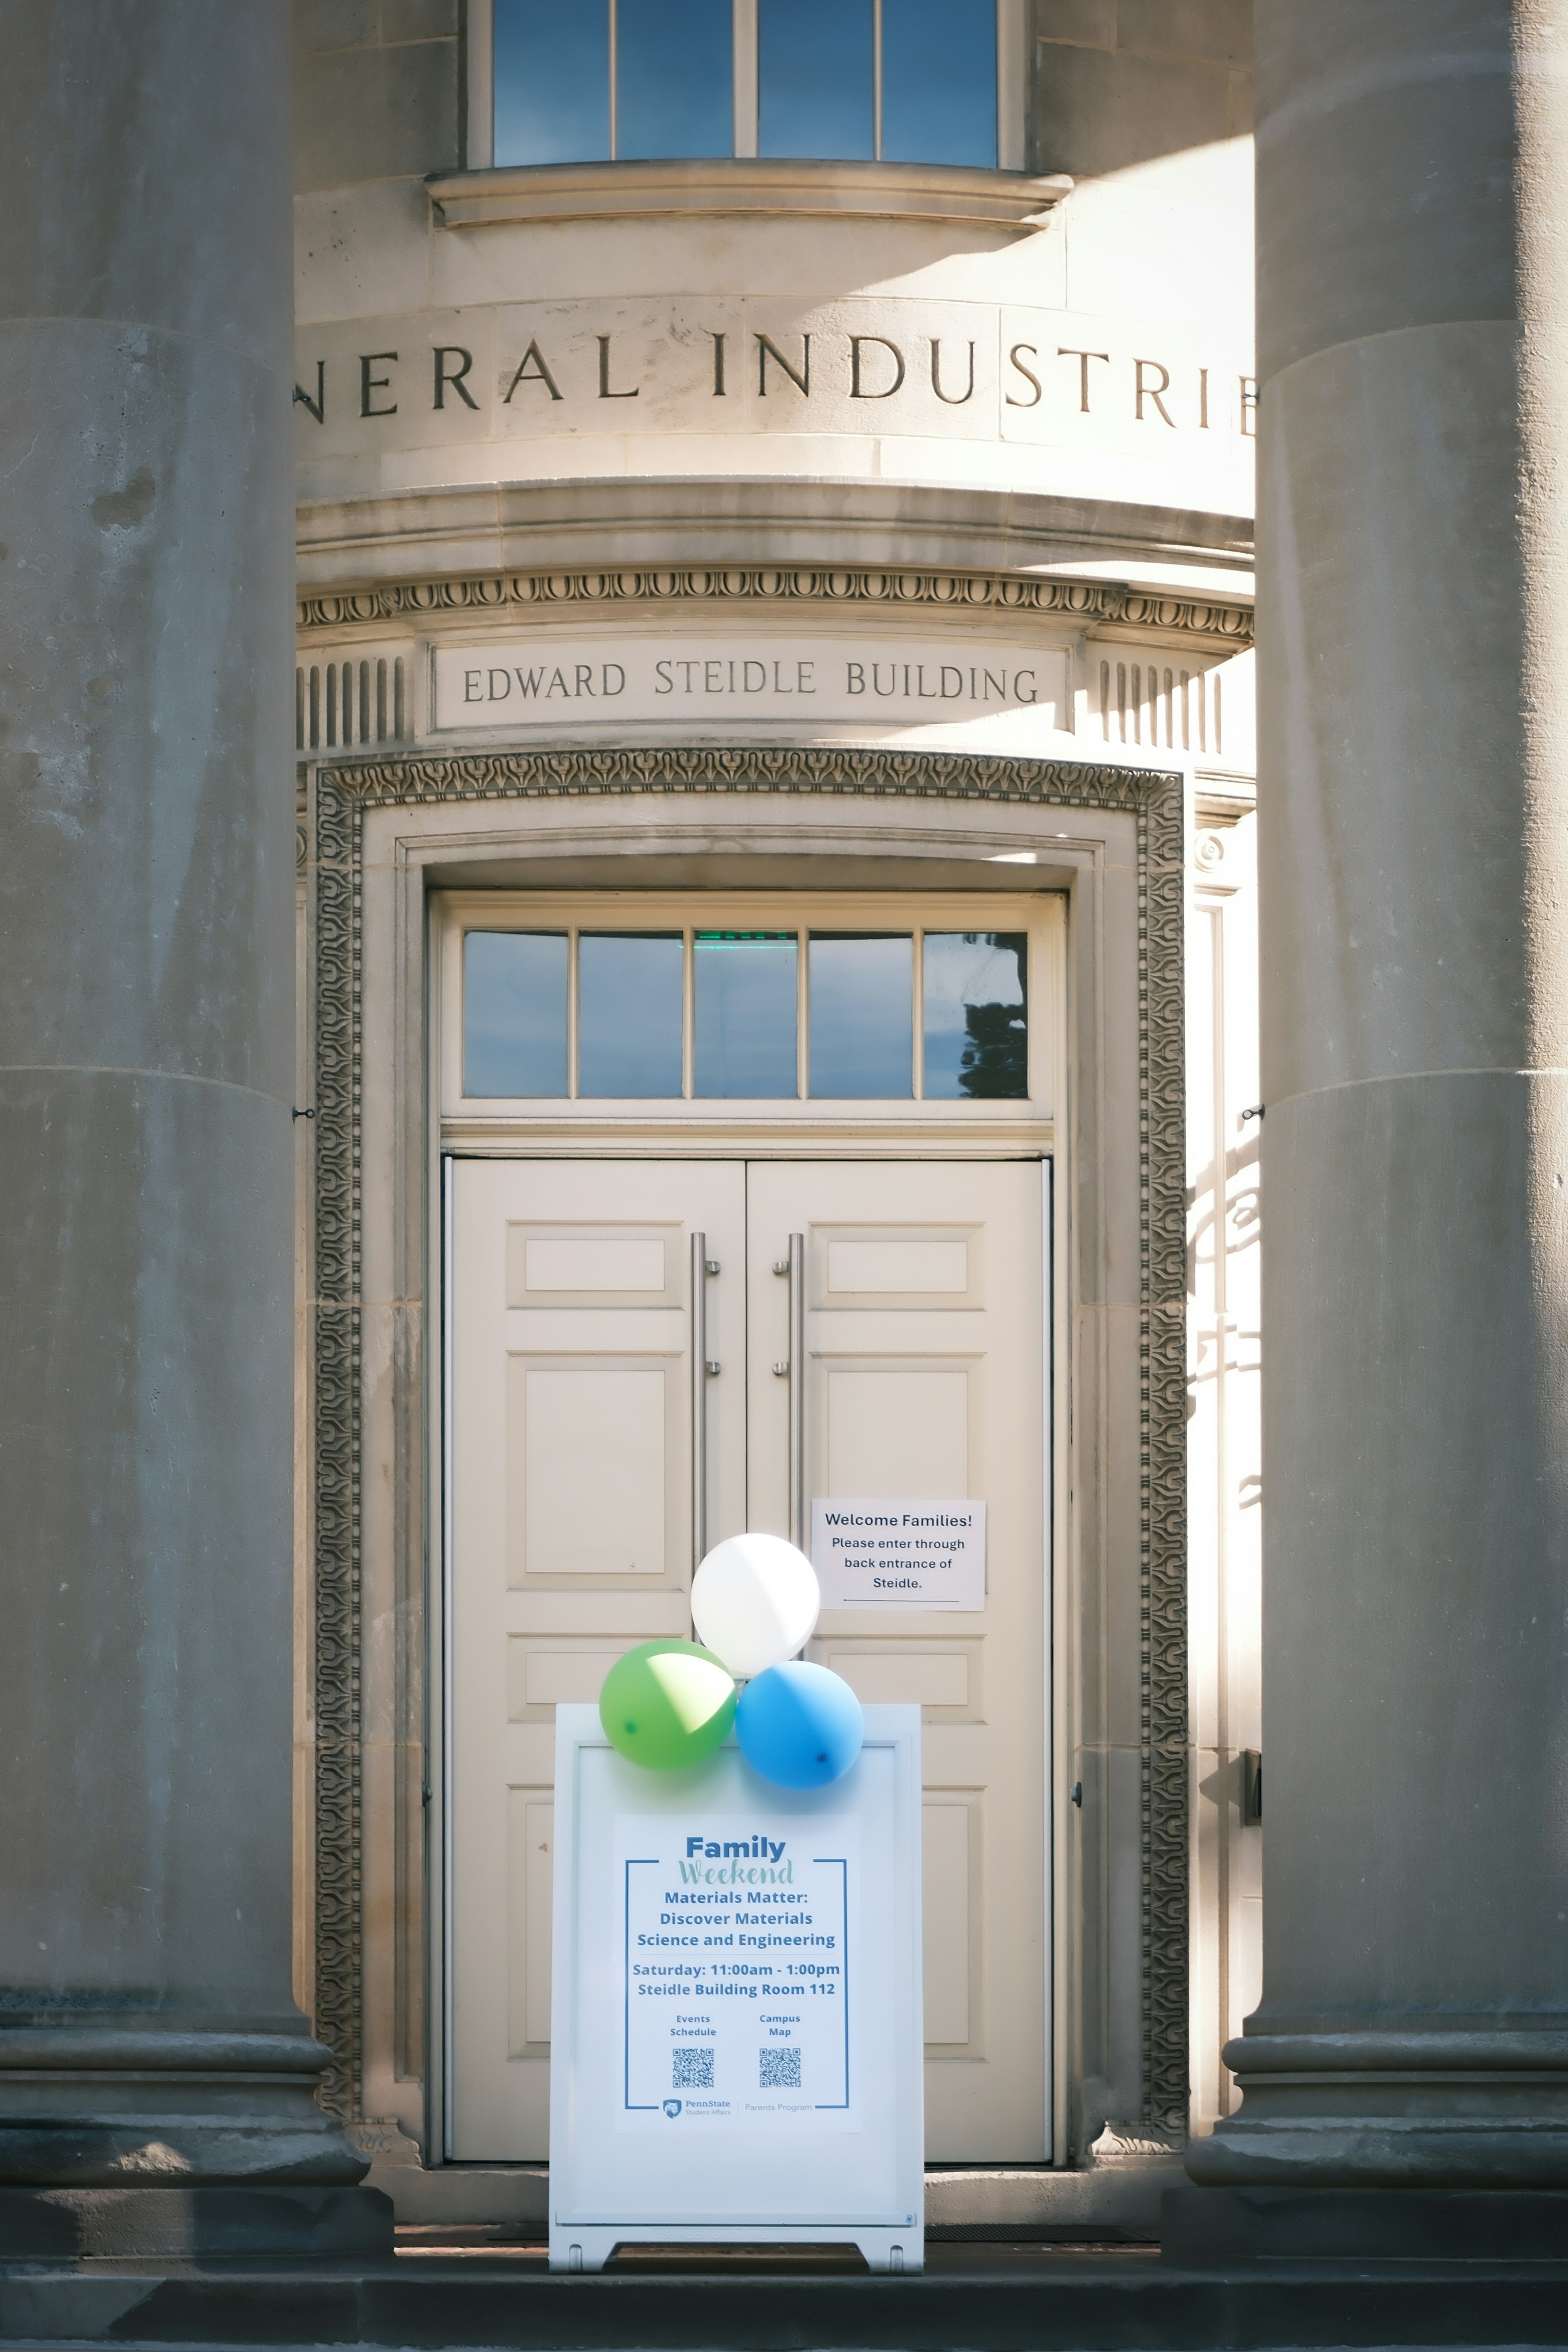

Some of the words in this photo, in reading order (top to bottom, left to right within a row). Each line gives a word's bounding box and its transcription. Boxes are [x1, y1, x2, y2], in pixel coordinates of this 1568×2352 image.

[463, 664, 625, 702] EDWARD
[655, 660, 816, 694] STEIDLE
[845, 662, 1038, 703] BUILDING
[825, 1513, 898, 1526] Welcome
[903, 1514, 972, 1527] Families!
[832, 1537, 874, 1548] Please
[878, 1539, 912, 1549] enter
[915, 1539, 964, 1551] through
[845, 1557, 876, 1568] back
[879, 1559, 936, 1568] entrance
[940, 1559, 952, 1569] of
[873, 1578, 922, 1588] Steidle.
[687, 1835, 786, 1863] Family
[678, 1859, 794, 1884] Weekend
[665, 1891, 742, 1904] Materials
[747, 1892, 808, 1903] Matter:
[660, 1912, 731, 1925] Discover
[735, 1912, 812, 1924] Materials
[638, 1933, 699, 1946] Science
[704, 1933, 733, 1946] and
[739, 1933, 835, 1949] Engineering
[633, 1964, 706, 1978] Saturday:
[711, 1964, 773, 1975] 11:00am
[786, 1964, 840, 1978] 1:00pm
[638, 1983, 691, 1995] Steidle
[696, 1983, 758, 1998] Building
[762, 1984, 805, 1995] Room
[810, 1983, 835, 1994] 112
[760, 2015, 800, 2024] Campus
[670, 2028, 716, 2036] Schedule
[769, 2028, 791, 2038] Map
[777, 2103, 812, 2113] Program
